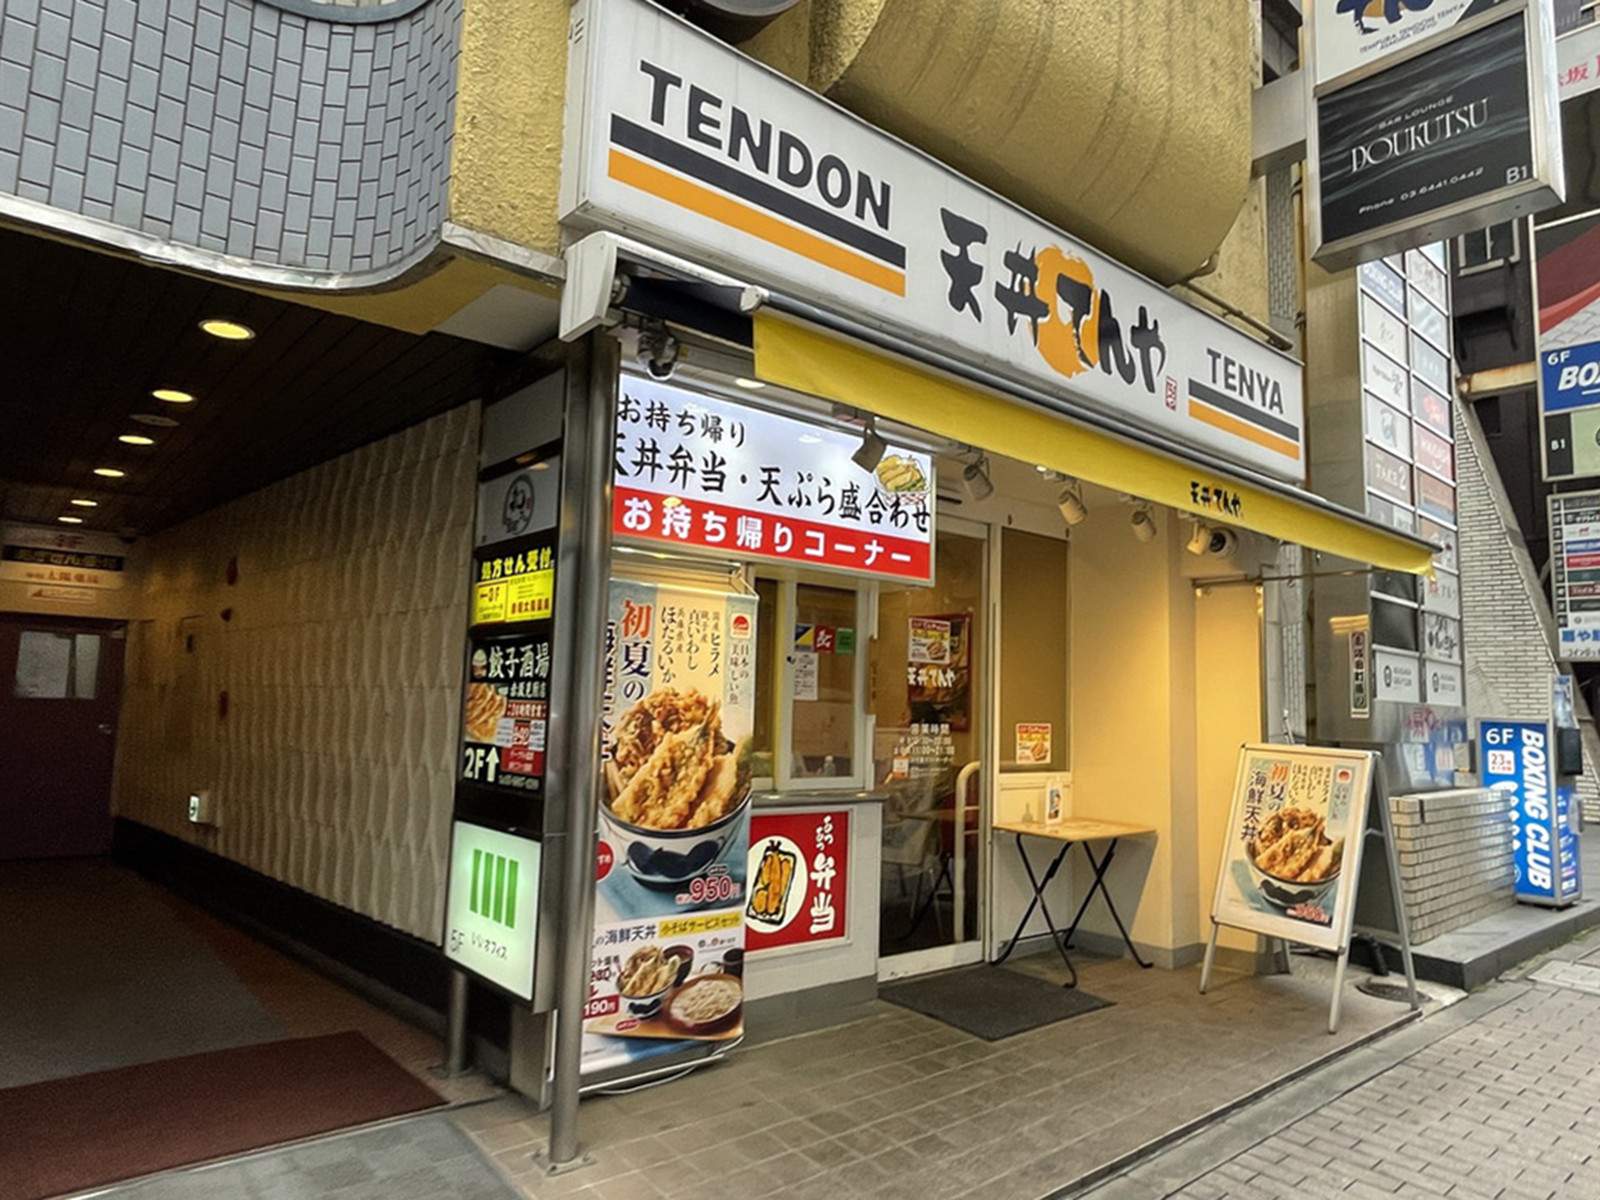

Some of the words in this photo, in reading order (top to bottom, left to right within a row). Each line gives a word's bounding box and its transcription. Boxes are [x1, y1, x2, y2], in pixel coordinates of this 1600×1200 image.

[1350, 98, 1490, 173] DOUKUTSU
[1404, 95, 1454, 120] LOUNGE
[640, 60, 891, 230] TENDON
[1506, 165, 1528, 185] B1
[940, 207, 1167, 393] 天丼てんや
[1206, 348, 1284, 414] TENYA
[1547, 350, 1570, 366] 6F
[1558, 361, 1600, 391] BO
[617, 393, 746, 448] お持ち帰り
[1550, 438, 1566, 451] B1
[622, 495, 912, 567] お持ち帰りコーナー
[488, 642, 550, 679] 餃子酒場
[620, 599, 653, 701] 初夏の
[657, 606, 677, 684] ほたるいか
[463, 747, 486, 780] 2F
[1486, 728, 1514, 744] 6F
[1241, 770, 1267, 841] 海鮮天丼
[1521, 728, 1548, 821] BOXING
[1525, 822, 1551, 890] CLUB
